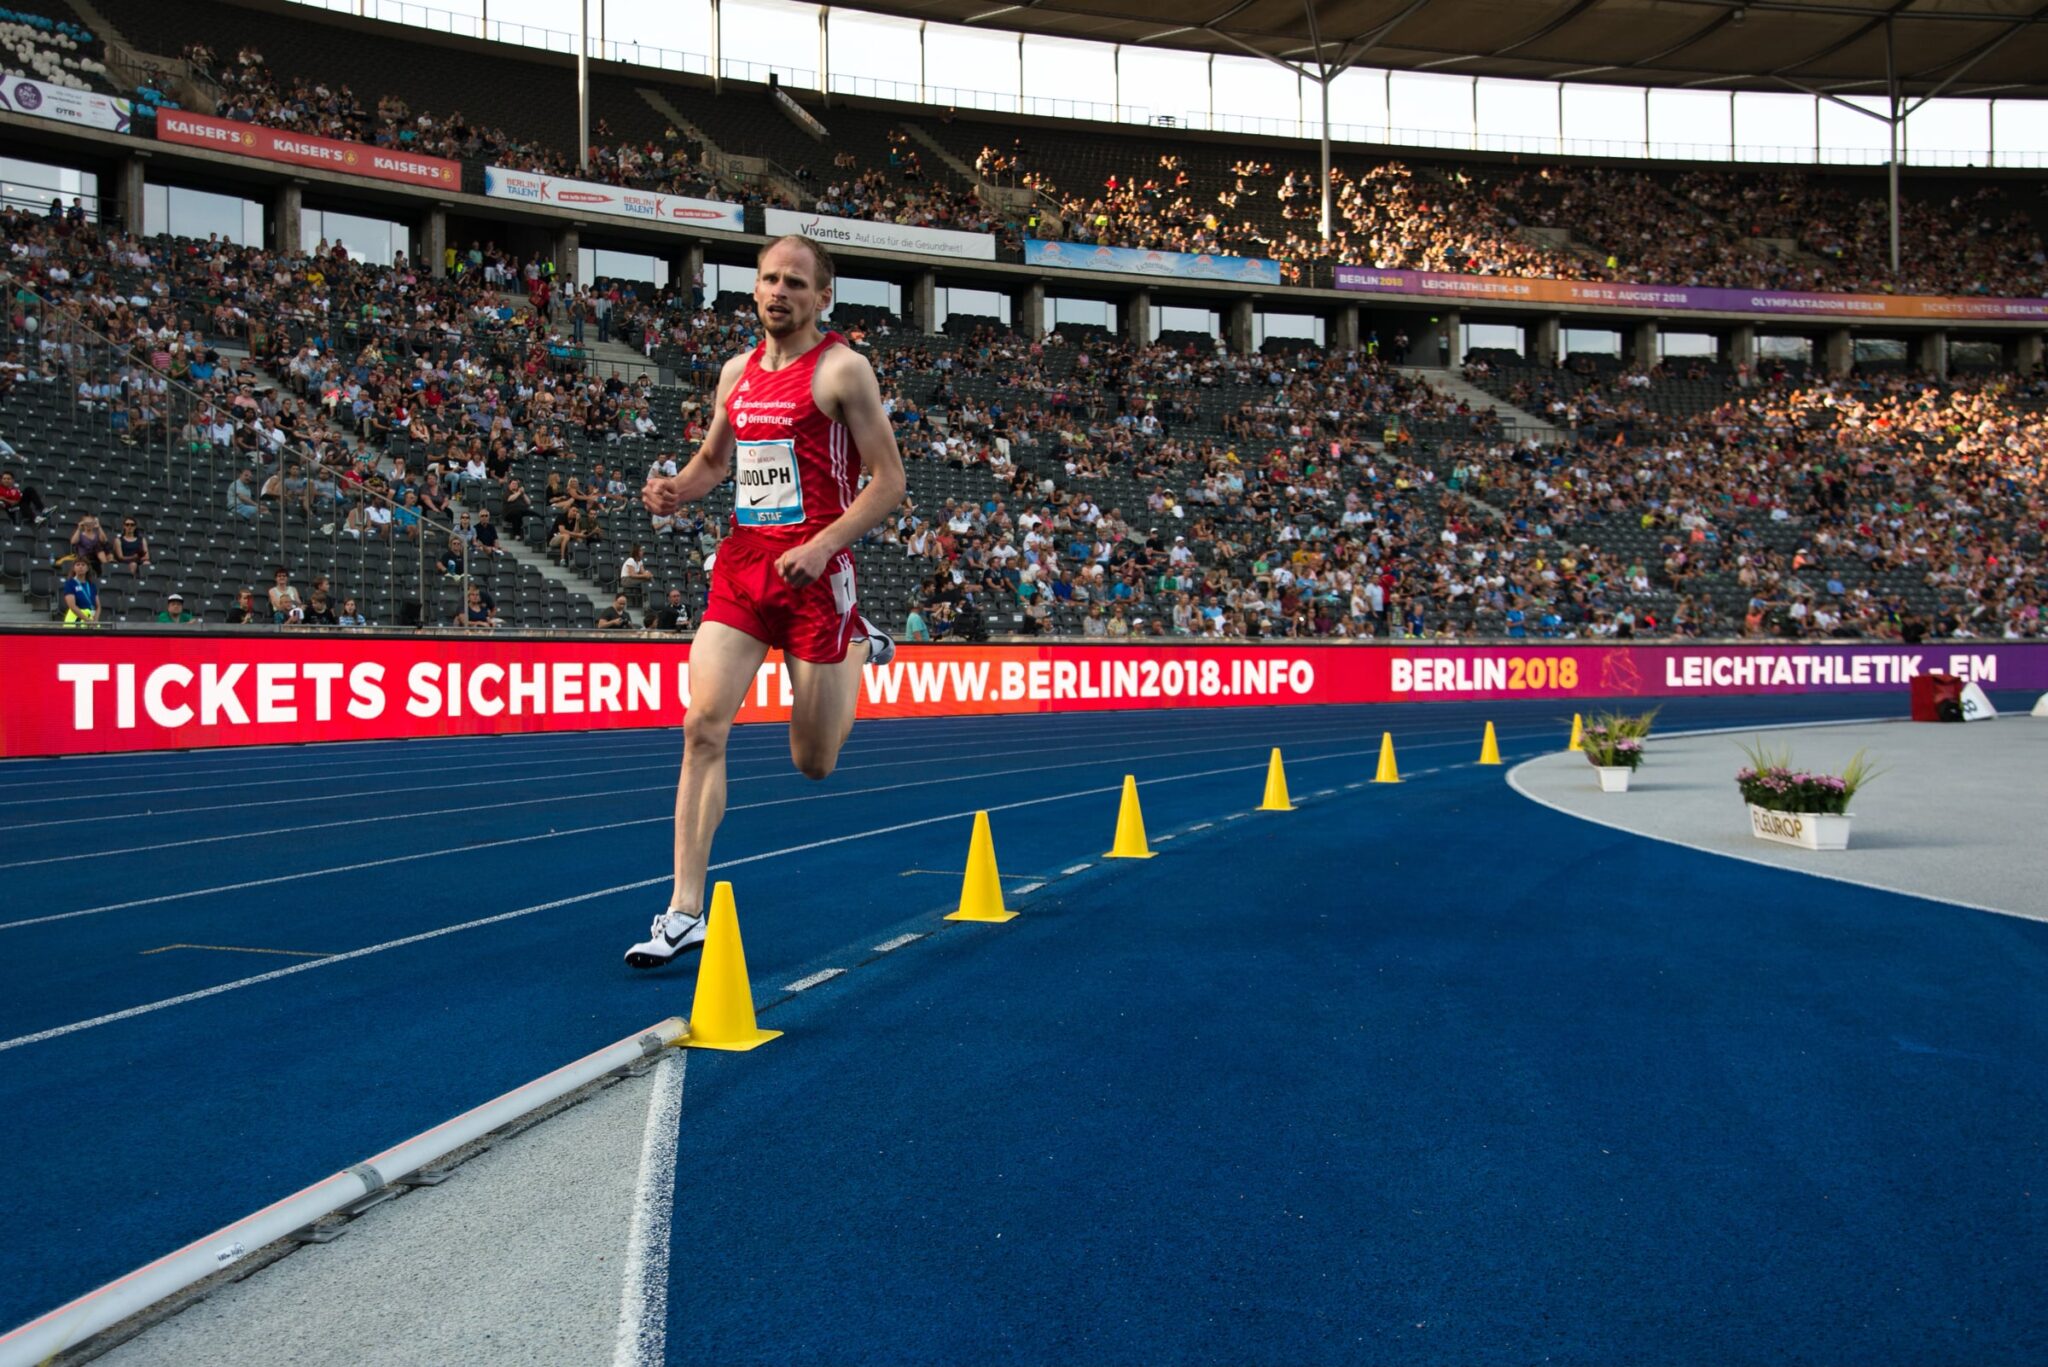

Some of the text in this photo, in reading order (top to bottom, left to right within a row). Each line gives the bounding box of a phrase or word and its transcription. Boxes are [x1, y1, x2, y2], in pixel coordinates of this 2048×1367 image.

[166, 119, 241, 143] KAISER'S
[273, 138, 343, 162] KAISER'S
[374, 156, 440, 178] KAISER'S
[507, 186, 539, 198] TALENT
[624, 203, 655, 214] TALENT
[801, 220, 851, 241] Vivantes
[901, 236, 914, 248] die
[1583, 289, 1600, 299] BIS
[1602, 290, 1616, 300] 12.
[1618, 291, 1661, 302] AUGUST
[1663, 292, 1687, 303] 2018
[1751, 297, 1845, 311] OLYMPIASTADION
[1847, 299, 1885, 311] BERLIN
[1922, 302, 1963, 313] TICKETS
[748, 414, 794, 426] ÖFFENTLICHE
[757, 511, 782, 522] ISTAF
[58, 661, 386, 731] TICKETS
[406, 661, 661, 718] SICHERN
[862, 660, 1314, 704] WWW.BERLIN2018.INFO
[1752, 809, 1803, 839] FLEUROP
